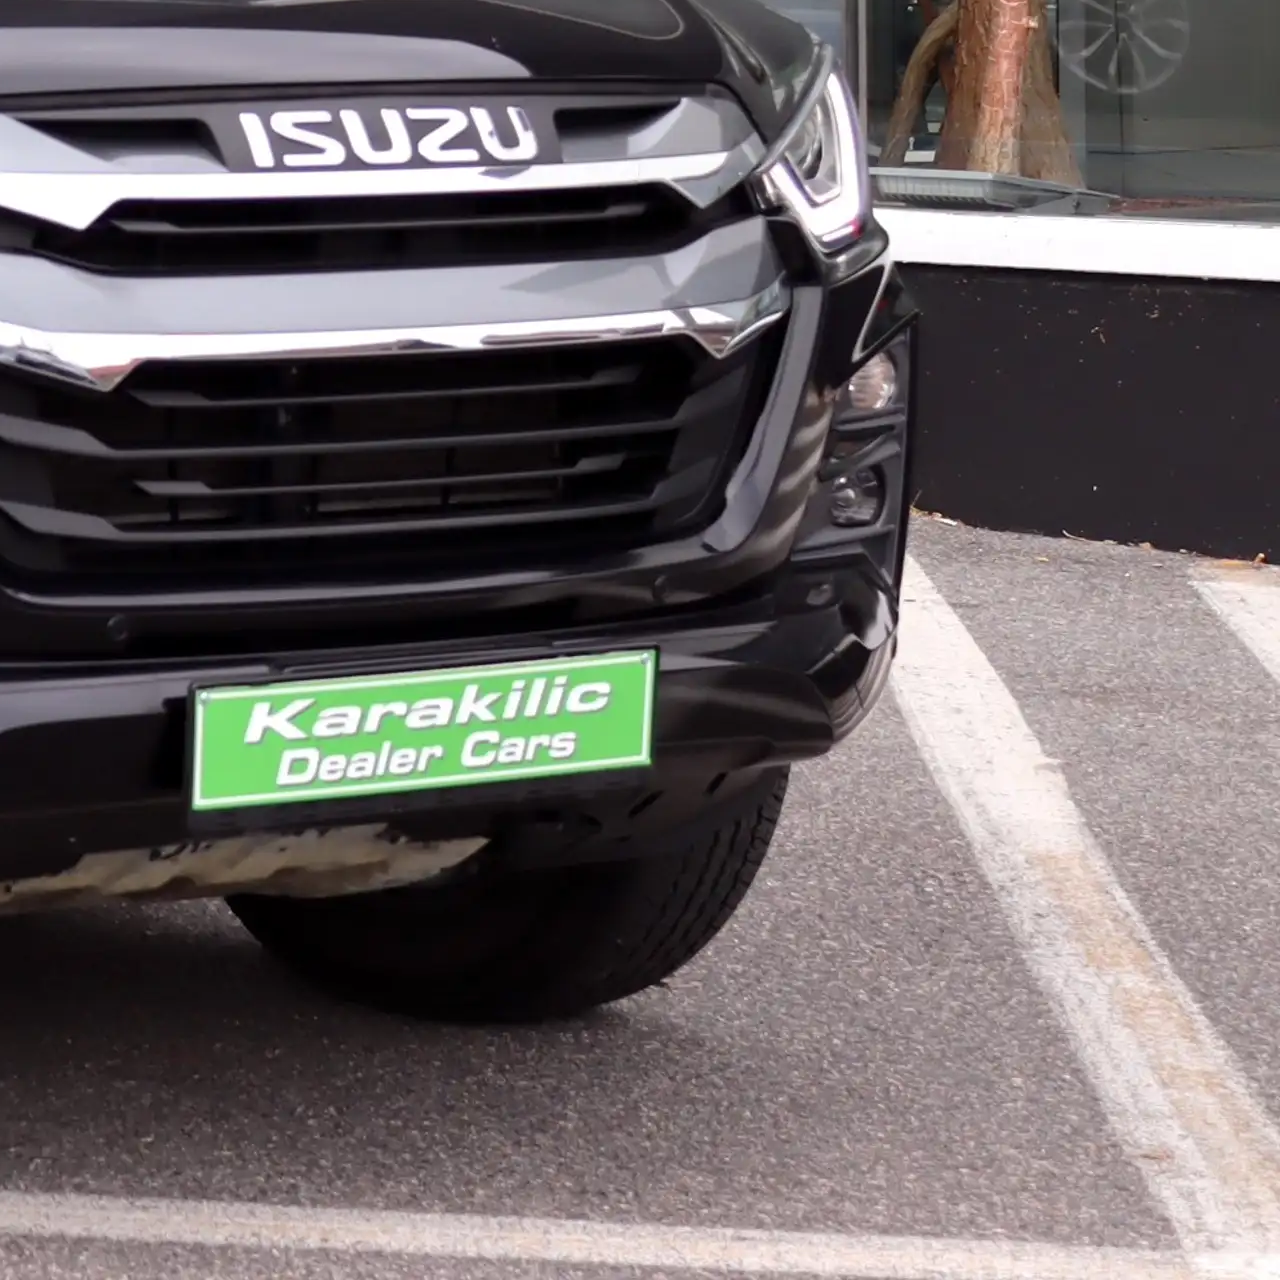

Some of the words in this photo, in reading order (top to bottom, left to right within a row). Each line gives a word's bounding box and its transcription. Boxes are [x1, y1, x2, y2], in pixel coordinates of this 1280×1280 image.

[239, 106, 538, 168] ISUZU
[243, 676, 613, 745] Karakilic
[275, 741, 444, 787] Dealer
[460, 729, 577, 774] Cars
